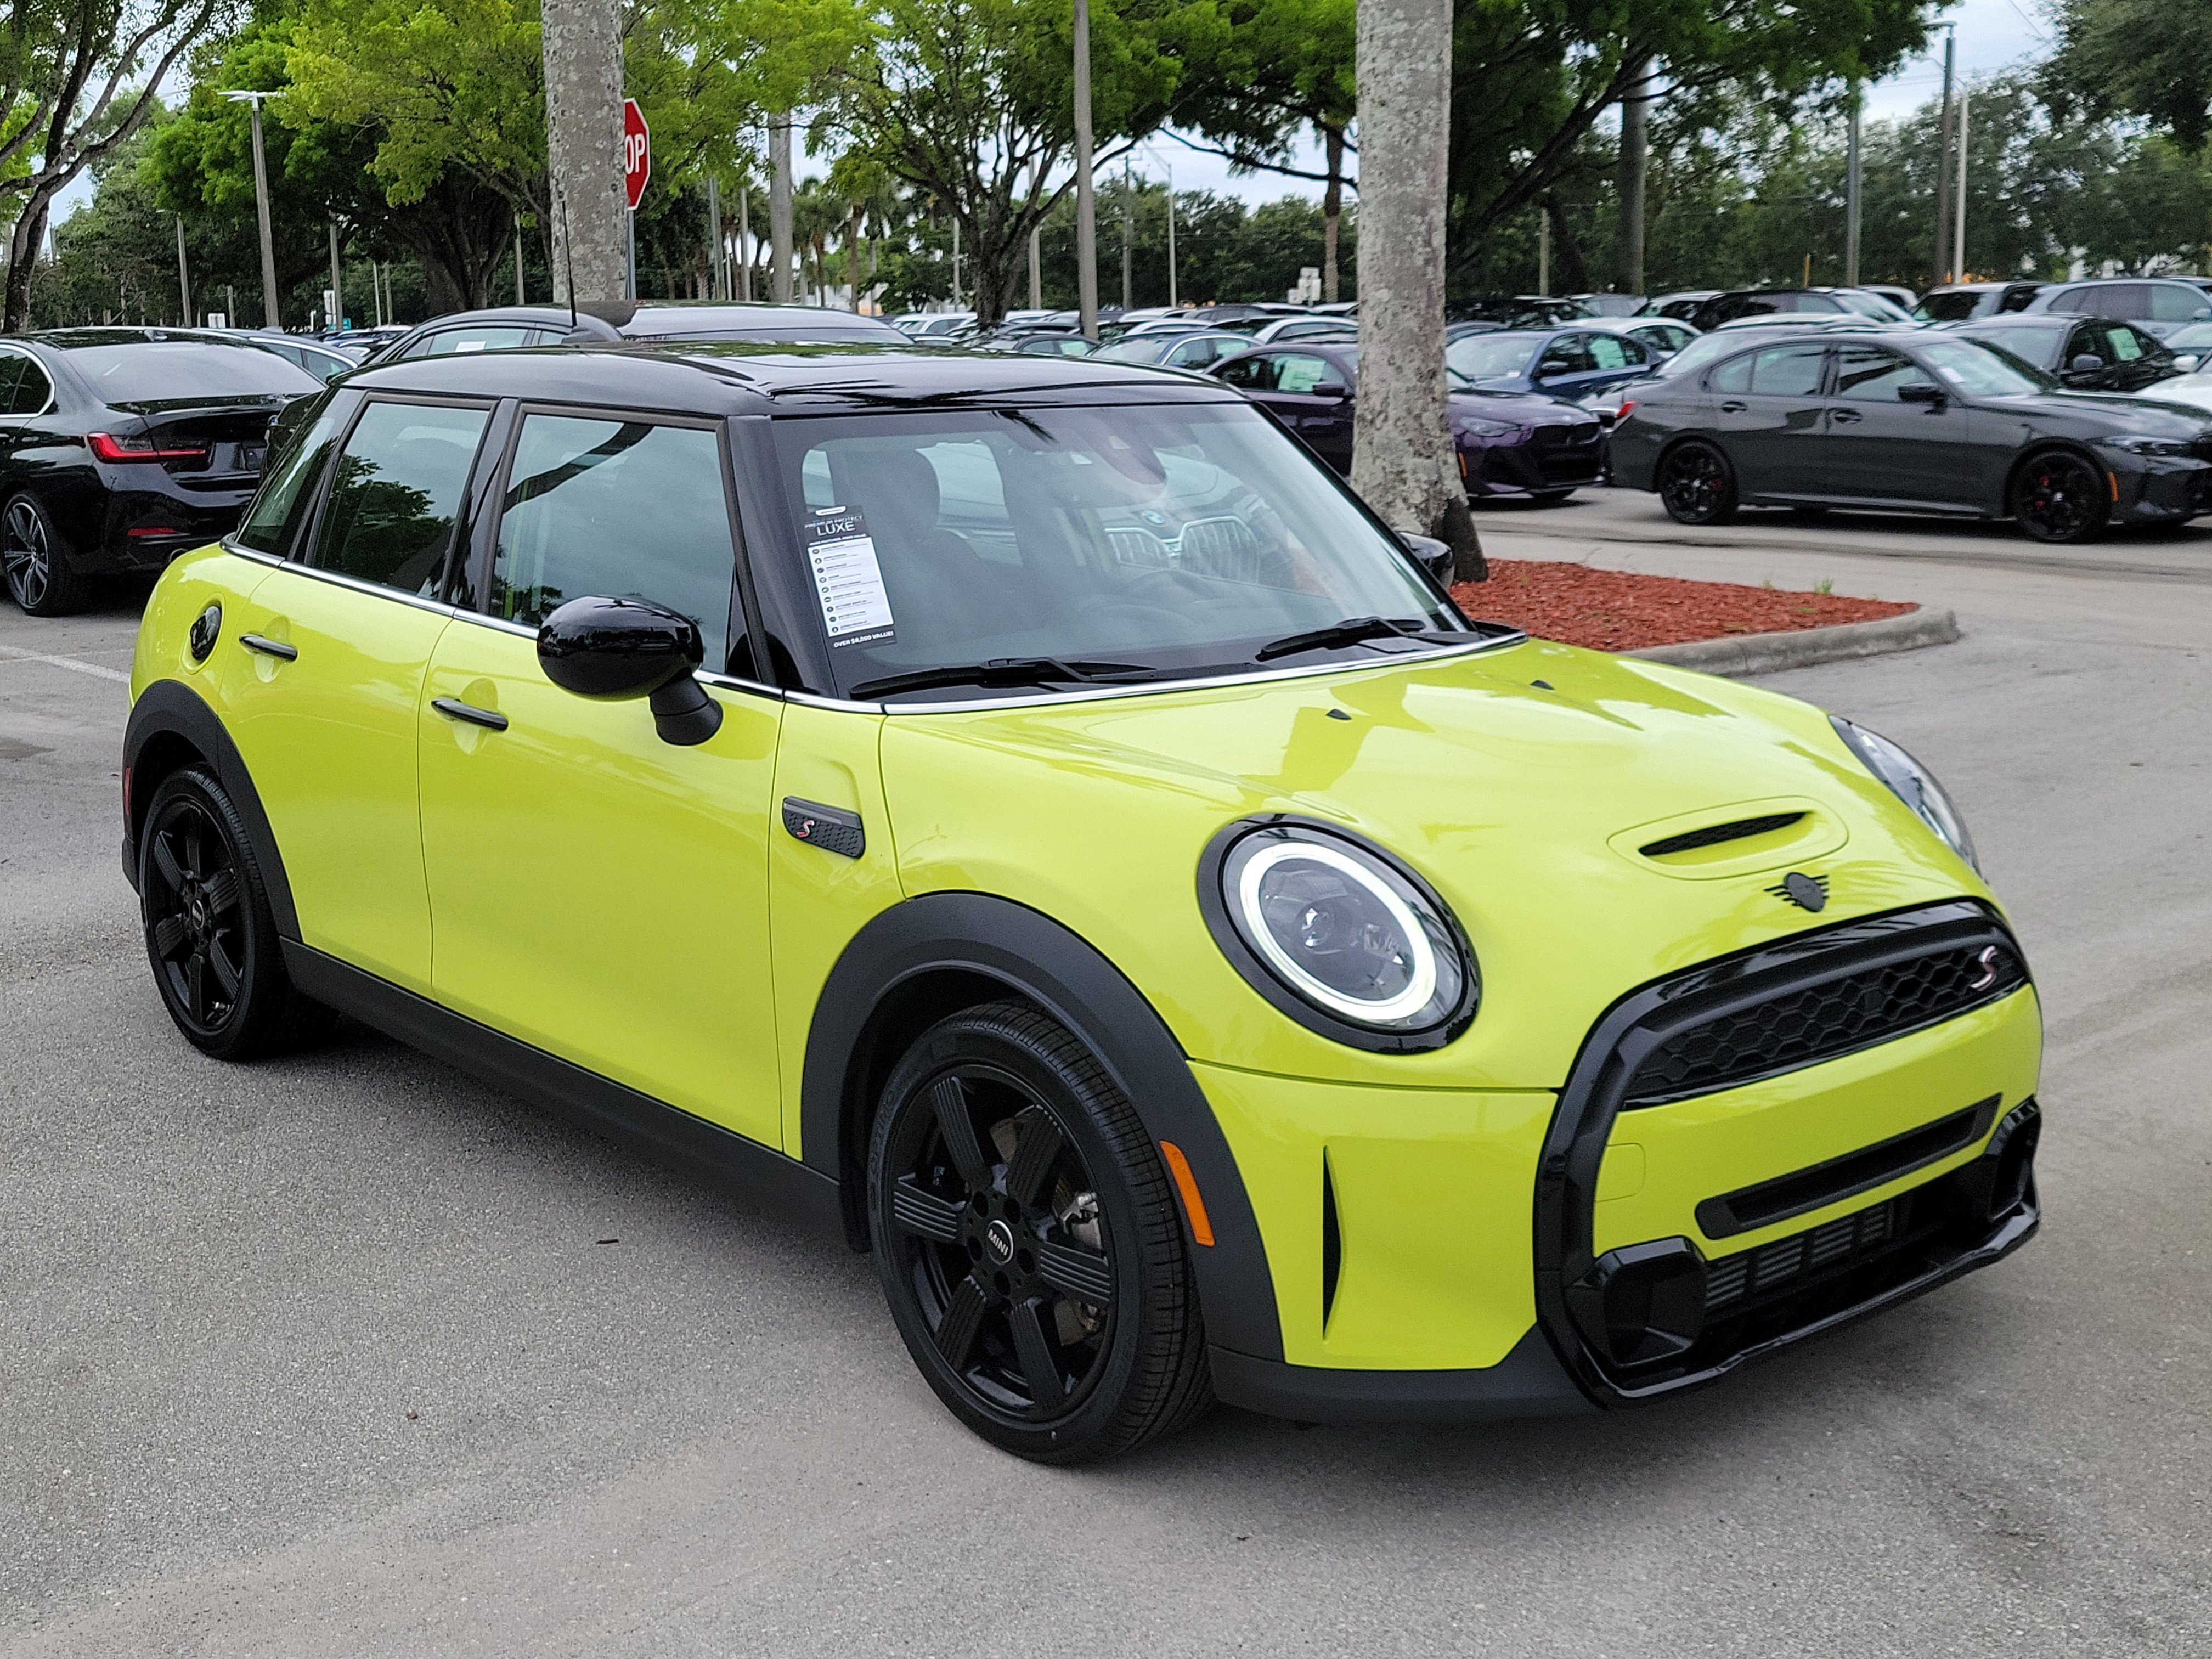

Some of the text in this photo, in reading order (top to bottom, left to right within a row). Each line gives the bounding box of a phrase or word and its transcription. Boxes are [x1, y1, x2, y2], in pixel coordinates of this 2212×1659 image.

[625, 133, 645, 174] OP
[816, 521, 855, 536] LUXE
[834, 640, 850, 648] OVER
[797, 820, 815, 837] S
[1970, 945, 1998, 991] S
[988, 1228, 1009, 1256] MINI
